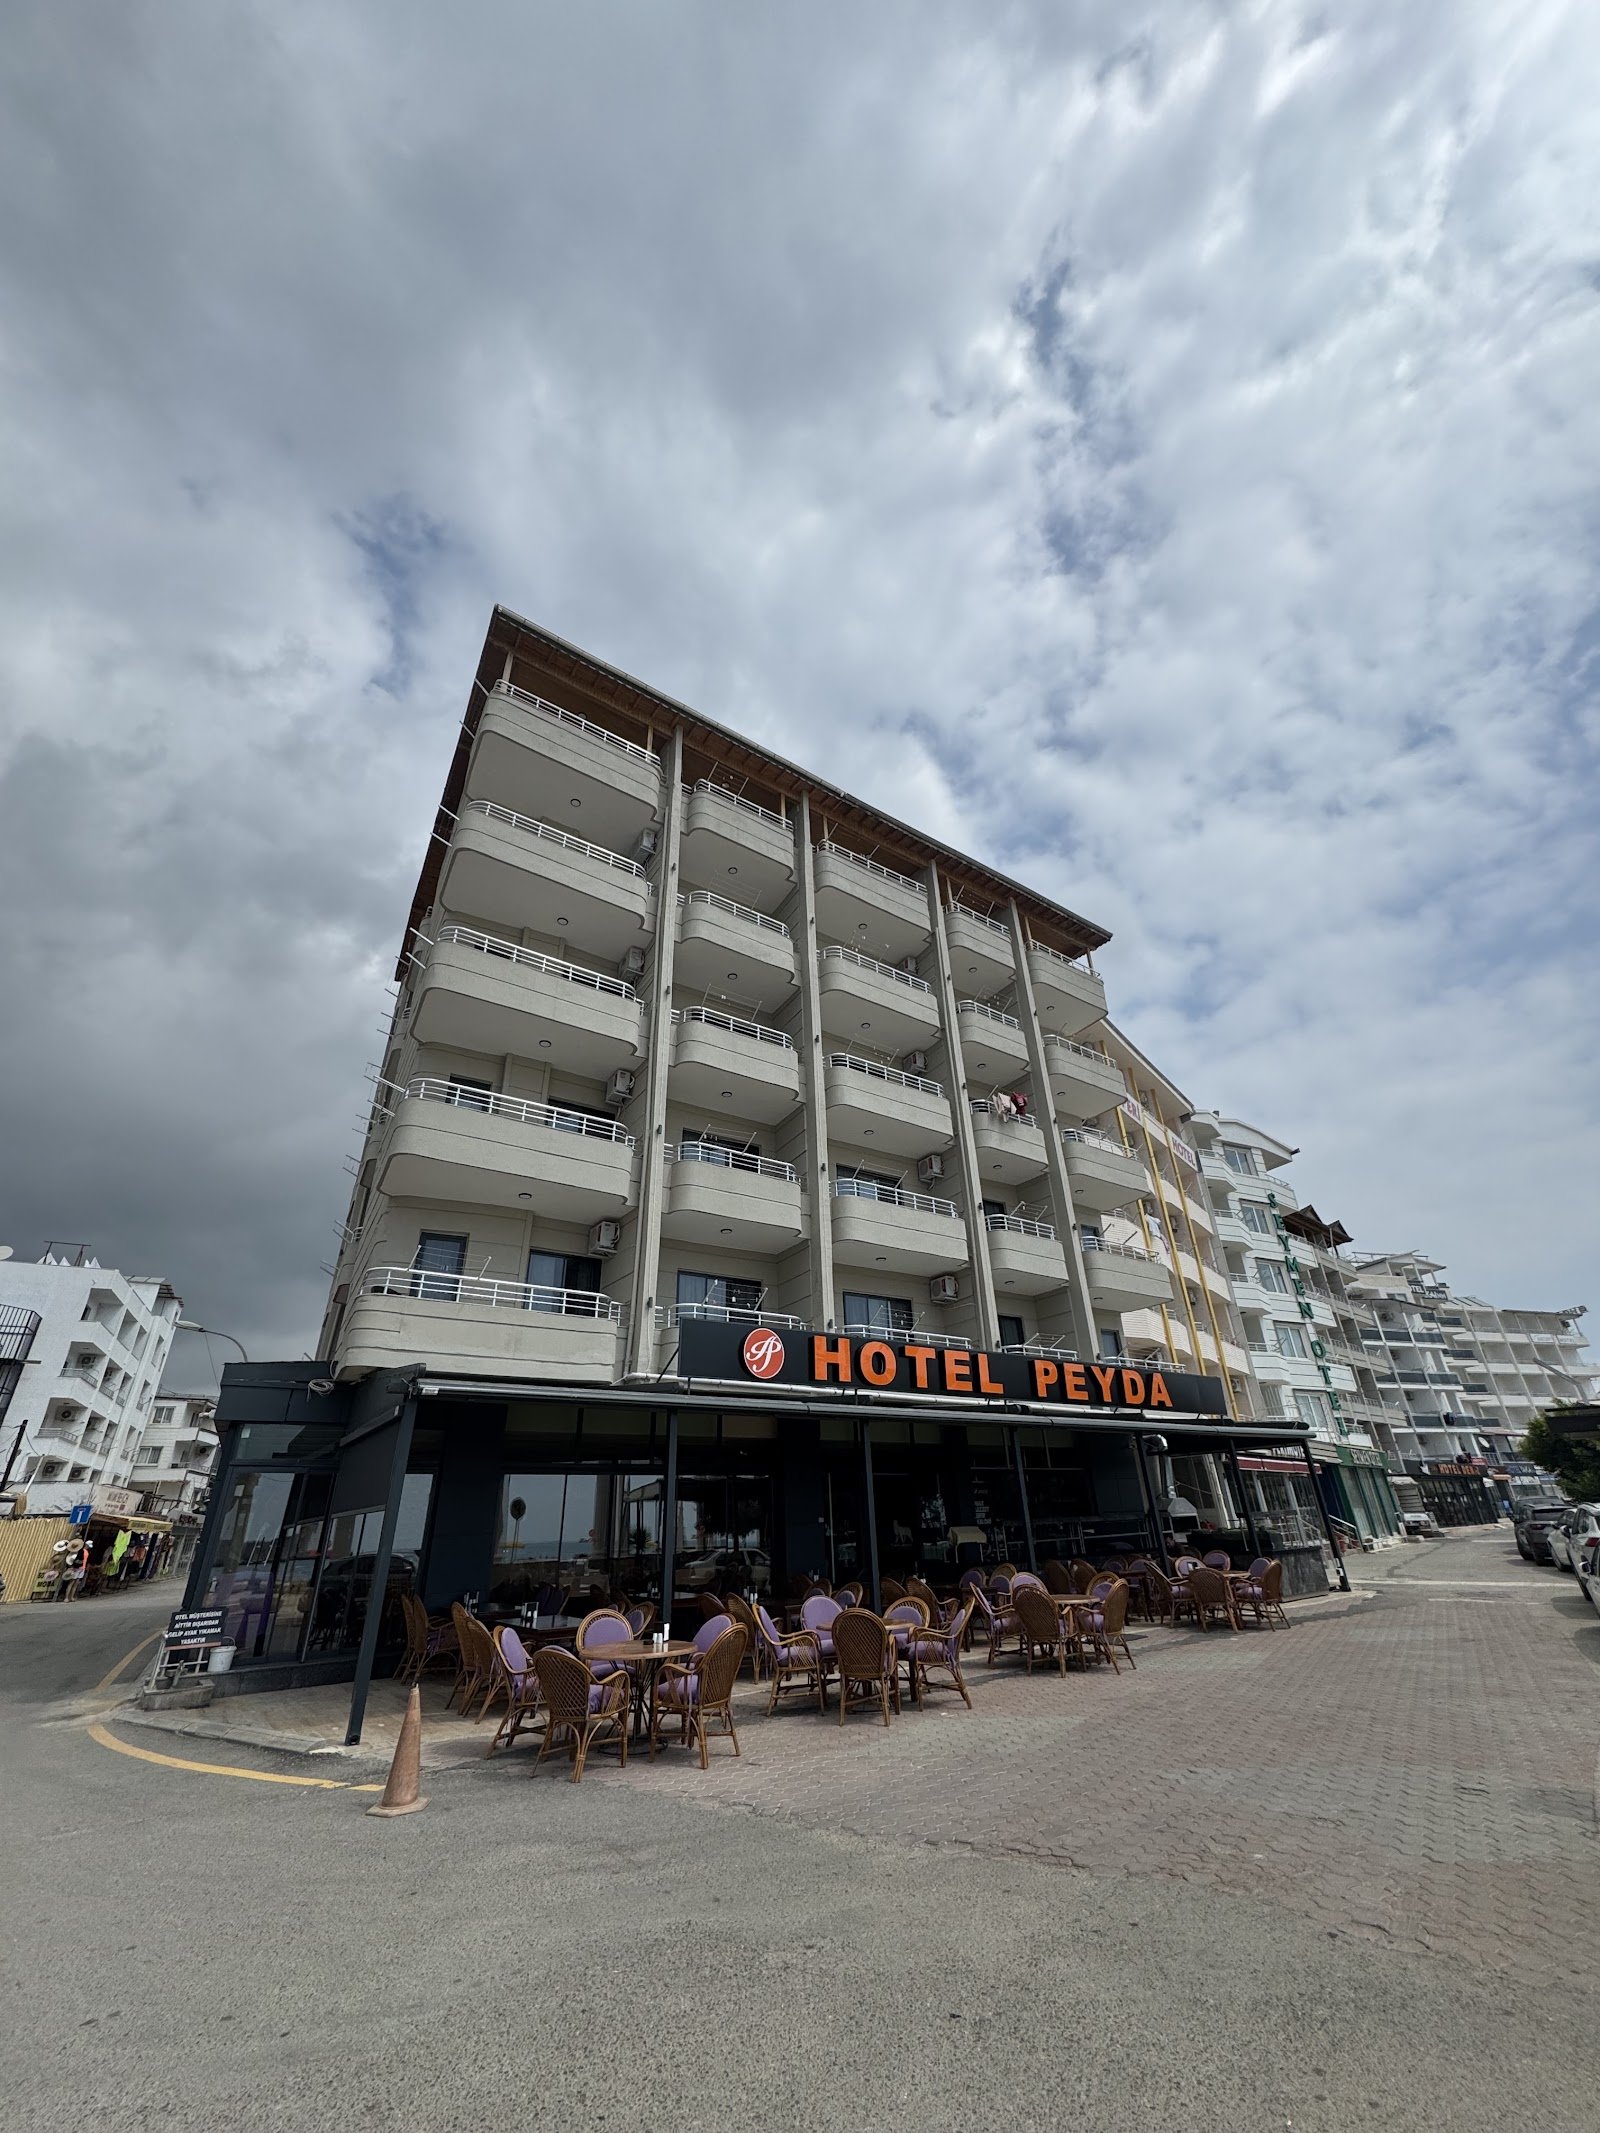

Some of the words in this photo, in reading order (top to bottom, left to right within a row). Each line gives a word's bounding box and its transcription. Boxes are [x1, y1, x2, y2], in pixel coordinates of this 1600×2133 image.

[1171, 1137, 1196, 1167] HOTEL
[1267, 1192, 1314, 1320] SEYMEN
[1310, 1339, 1349, 1436] OTEL
[813, 1335, 1004, 1395] HOTEL
[1033, 1359, 1174, 1408] PEYDA
[1437, 1463, 1462, 1474] HOTEL
[180, 1637, 206, 1645] YASAKTIR
[183, 1629, 198, 1637] AYAK
[198, 1627, 222, 1636] YIKAMAK
